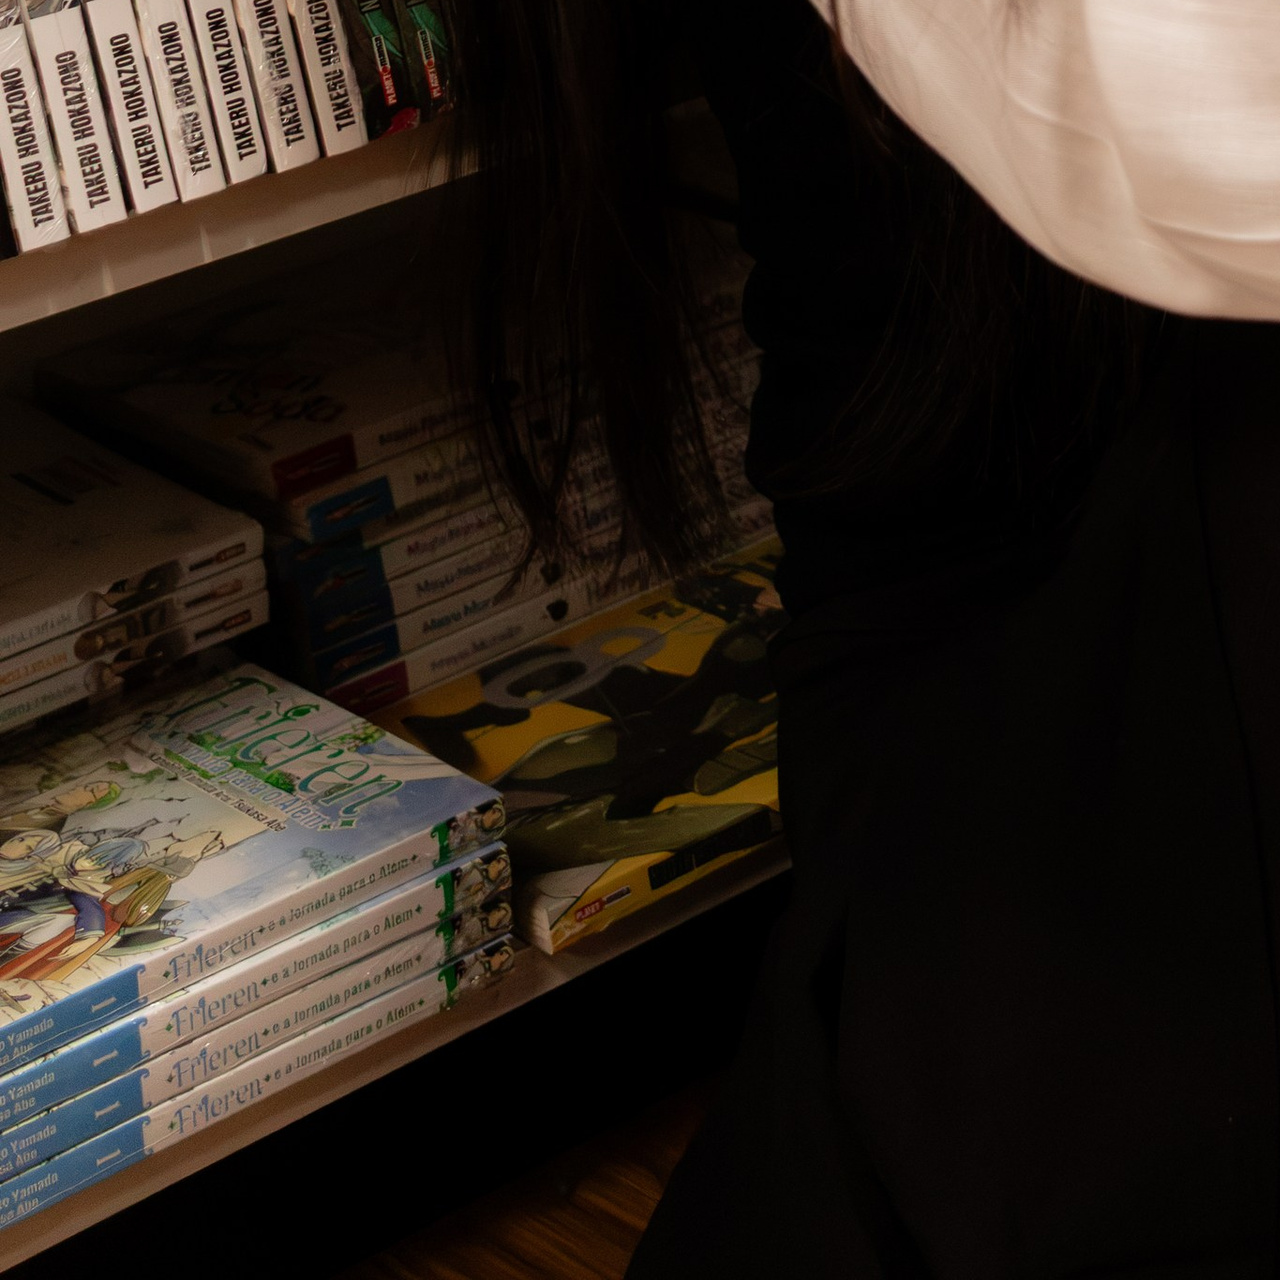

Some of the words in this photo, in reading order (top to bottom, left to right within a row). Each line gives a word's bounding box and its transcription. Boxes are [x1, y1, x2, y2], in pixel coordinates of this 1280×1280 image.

[110, 32, 149, 122] HOKAZONO
[158, 20, 196, 108] HOKAZONO
[206, 7, 242, 96] HOKAZONO
[426, 65, 442, 100] PLANET
[1, 67, 39, 159] HOKAZONO
[55, 50, 95, 141] HOKAZONO
[323, 71, 356, 132] TAKERU
[380, 71, 397, 107] PLANET
[131, 124, 164, 189] TAKERU
[227, 97, 258, 161] TAKERU
[21, 160, 55, 228] TAKERU
[77, 142, 111, 209] TAKERU
[163, 675, 403, 818] Frieren
[168, 931, 257, 983] Frieren
[171, 982, 260, 1037] Frieren
[293, 942, 340, 974] Jornada
[343, 929, 371, 954] para
[7, 1018, 54, 1045] Yamada
[173, 1032, 261, 1088] Frieren
[294, 992, 341, 1026] Jornada
[343, 979, 372, 1005] para
[9, 1073, 56, 1101] Yamada
[174, 1076, 263, 1135] Frieren
[296, 1039, 343, 1071] Jornada
[345, 1025, 373, 1050] para
[10, 1124, 57, 1152] Yamada
[11, 1172, 58, 1201] Yamada
